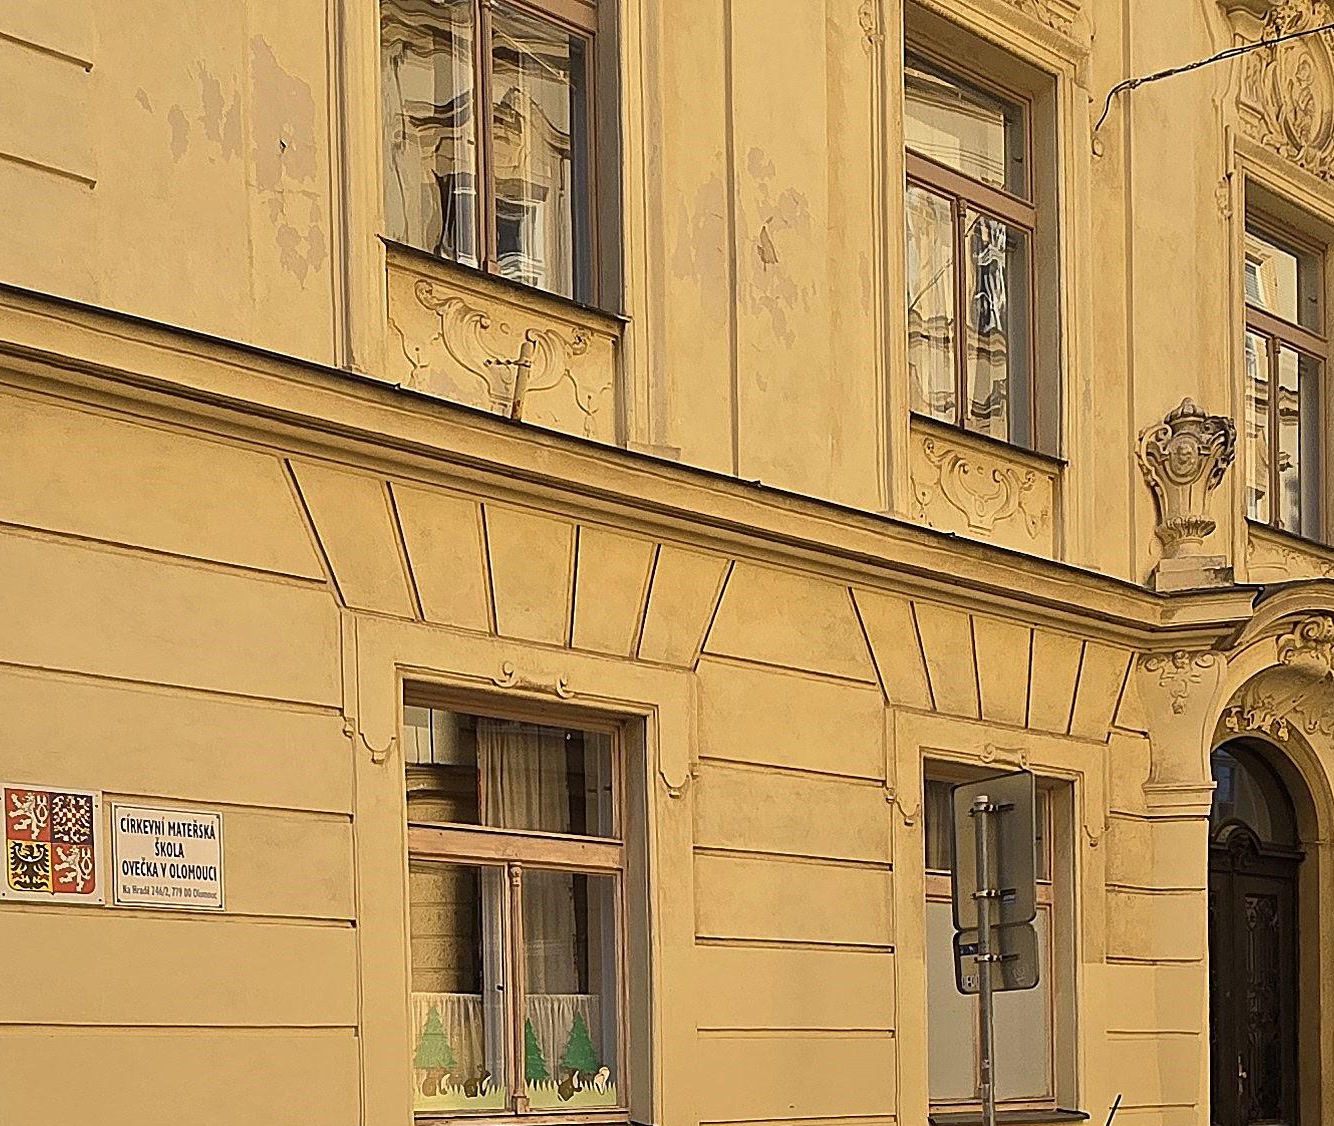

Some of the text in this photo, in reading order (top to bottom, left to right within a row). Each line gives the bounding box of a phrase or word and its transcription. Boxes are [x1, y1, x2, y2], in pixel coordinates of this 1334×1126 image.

[120, 813, 216, 840] CÍRKEVNÍ MATEŘSKÁ
[154, 837, 185, 858] ŠKOLA
[122, 857, 217, 881] OVEČKA V OLOMOUCI
